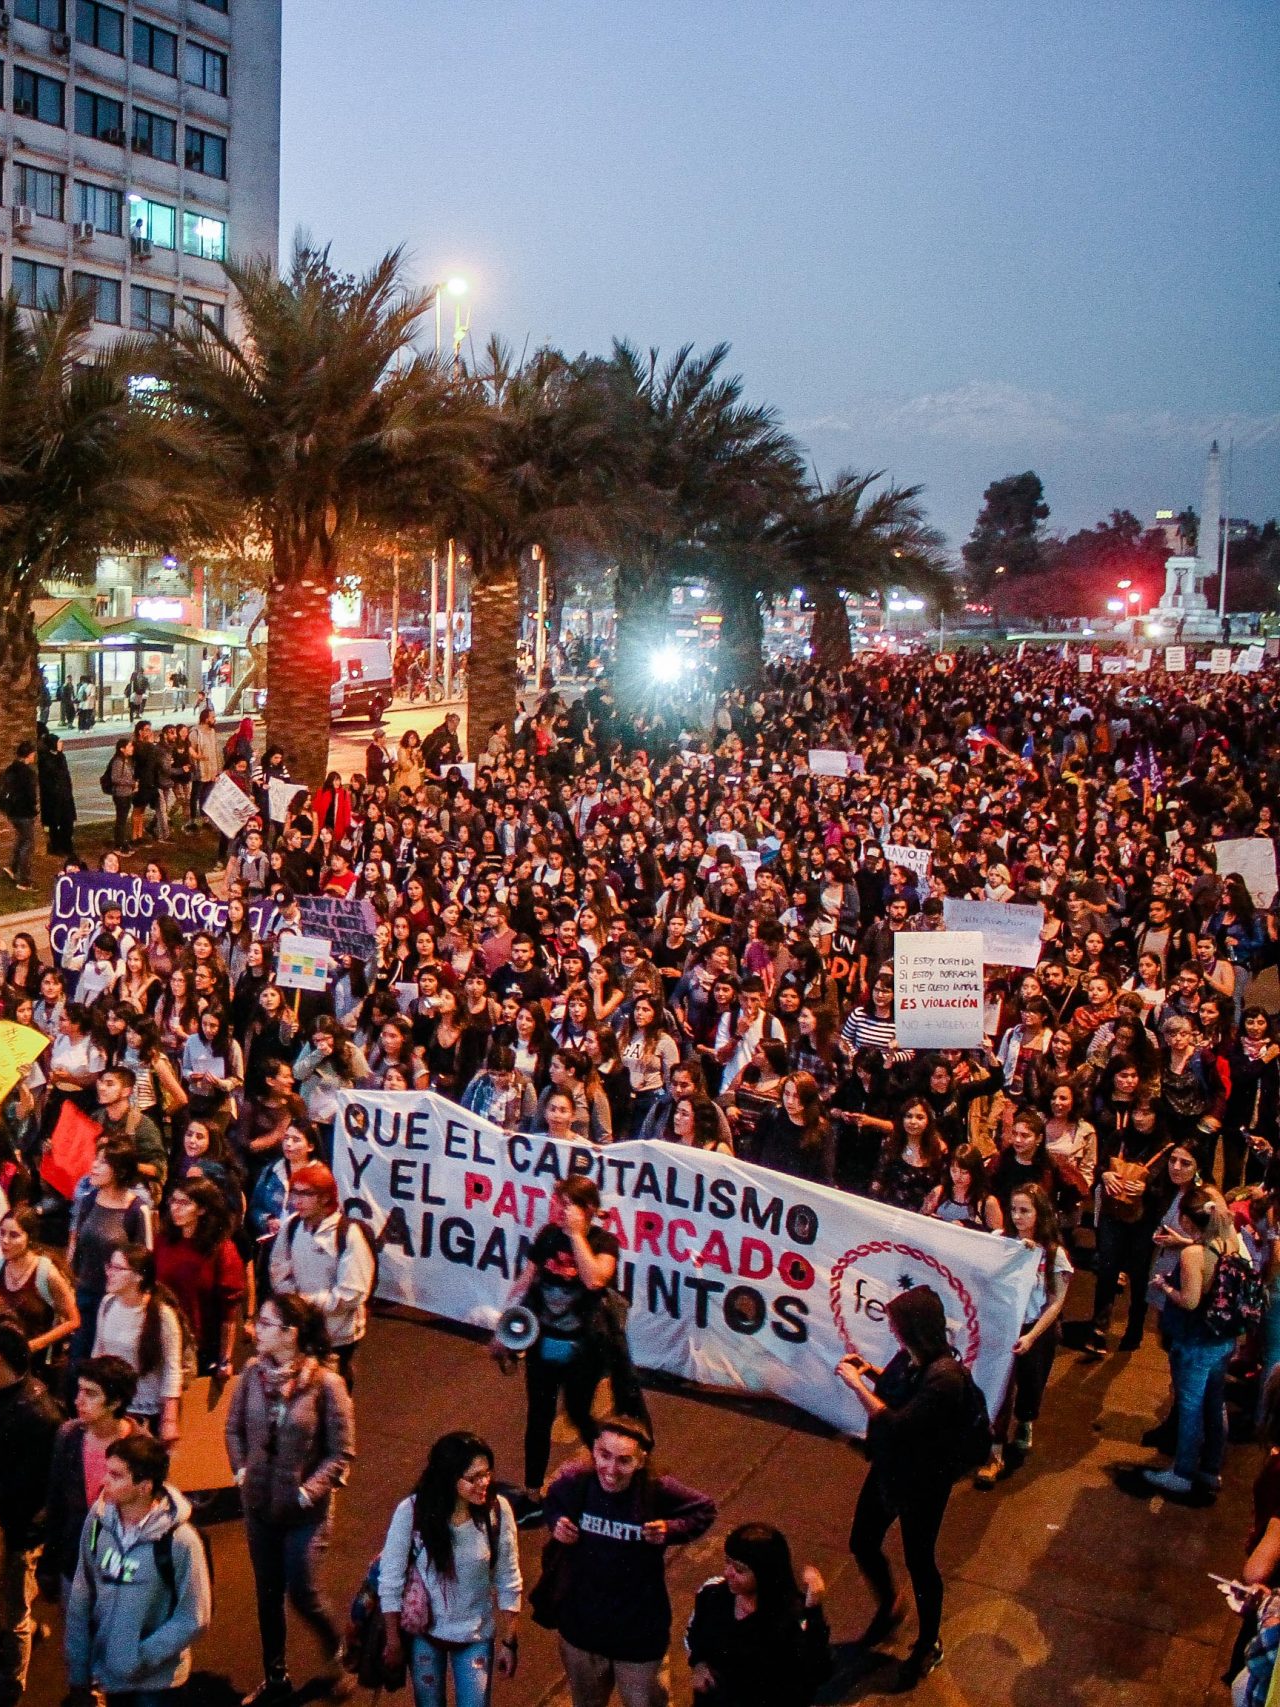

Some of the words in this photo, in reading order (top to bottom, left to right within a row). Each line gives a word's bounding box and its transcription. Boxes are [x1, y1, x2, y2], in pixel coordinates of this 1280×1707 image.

[55, 876, 156, 918] Cuando
[913, 956, 935, 966] ESTOY
[938, 957, 975, 966] DORMIDA
[911, 970, 934, 980] ESTOY
[939, 970, 978, 979] BORRACHA
[913, 983, 925, 992] ME
[927, 983, 949, 992] QUEDO
[900, 998, 916, 1009] ES
[344, 1103, 430, 1151] QUE
[444, 1120, 496, 1165] EL
[508, 1134, 818, 1246] CAPITALISMO
[347, 1147, 373, 1190] Y
[389, 1159, 446, 1206] EL
[464, 1171, 815, 1291] PATARCADO
